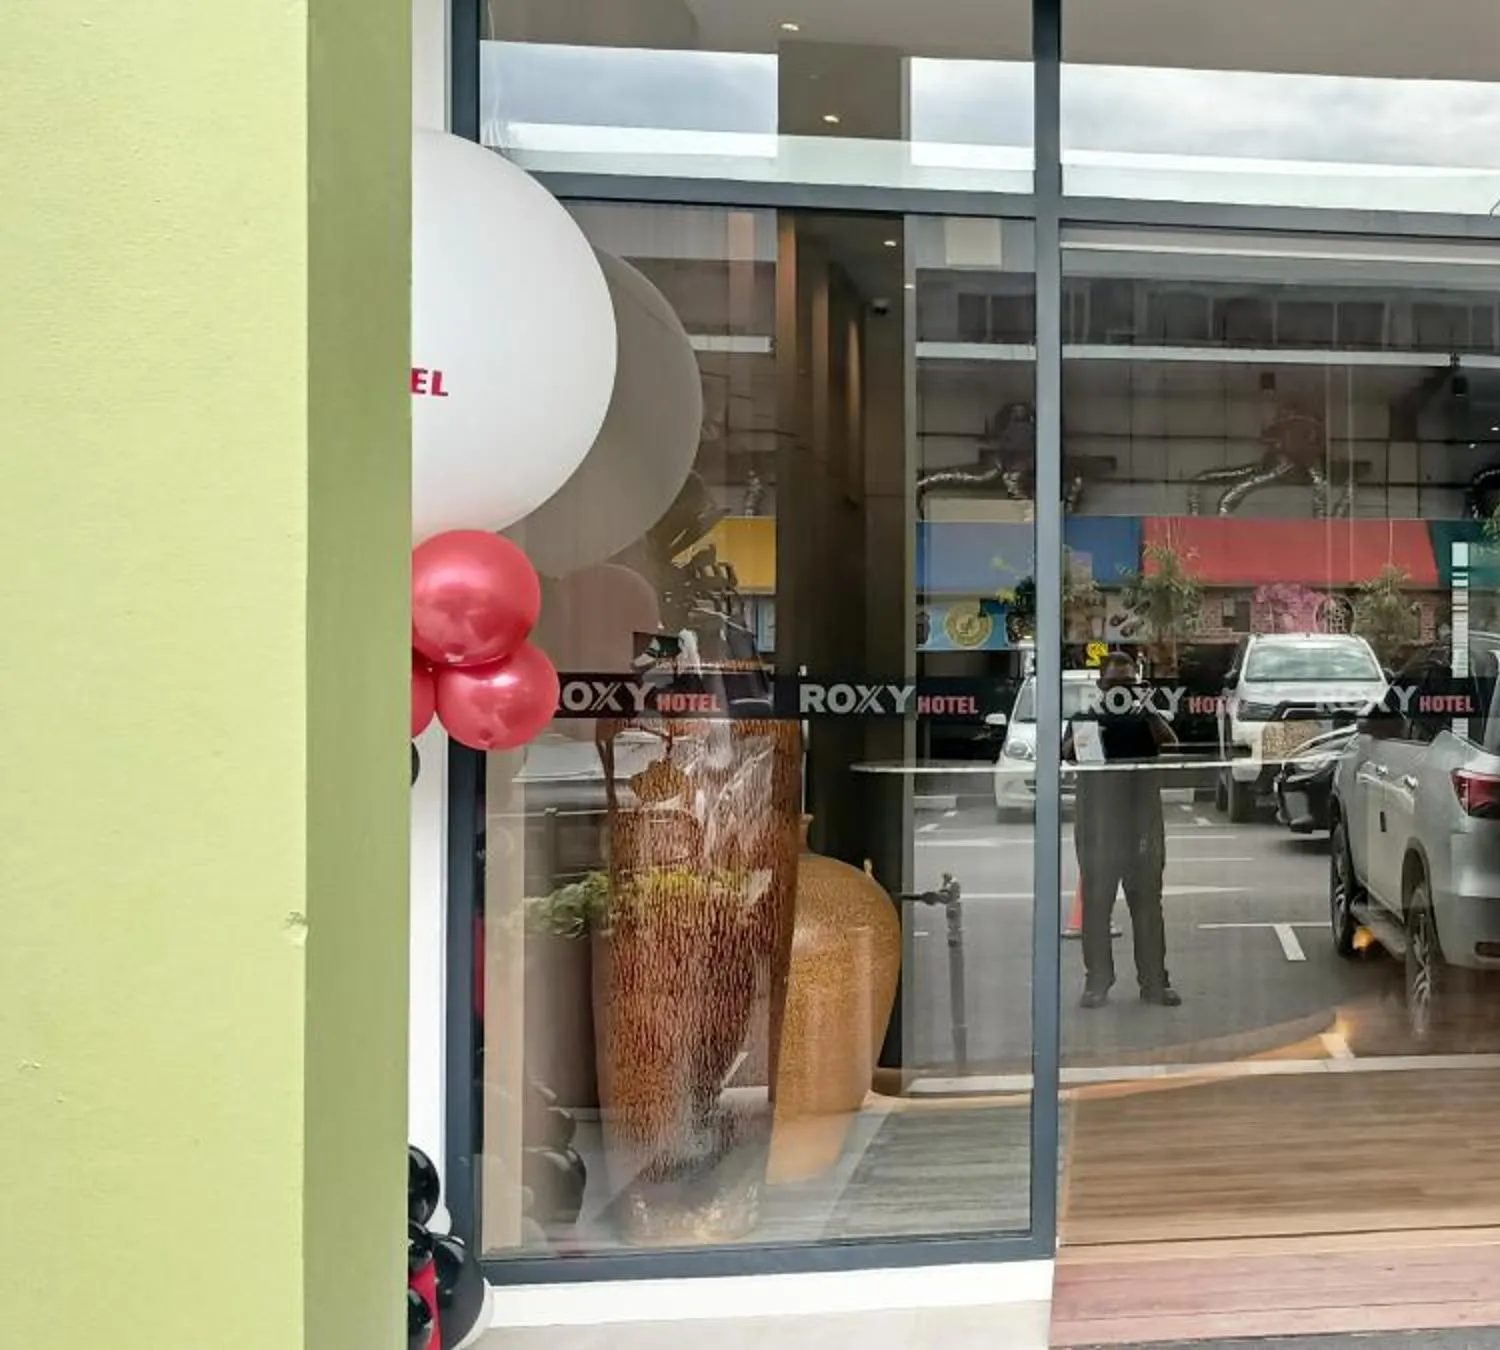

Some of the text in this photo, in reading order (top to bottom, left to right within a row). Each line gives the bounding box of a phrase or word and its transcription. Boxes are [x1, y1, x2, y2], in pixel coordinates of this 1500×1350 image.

[558, 681, 721, 712] OXY HOTEL
[800, 683, 979, 714] ROXY HOTEL
[1080, 685, 1238, 715] ROXY HOT
[1419, 695, 1475, 713] HOTEL
